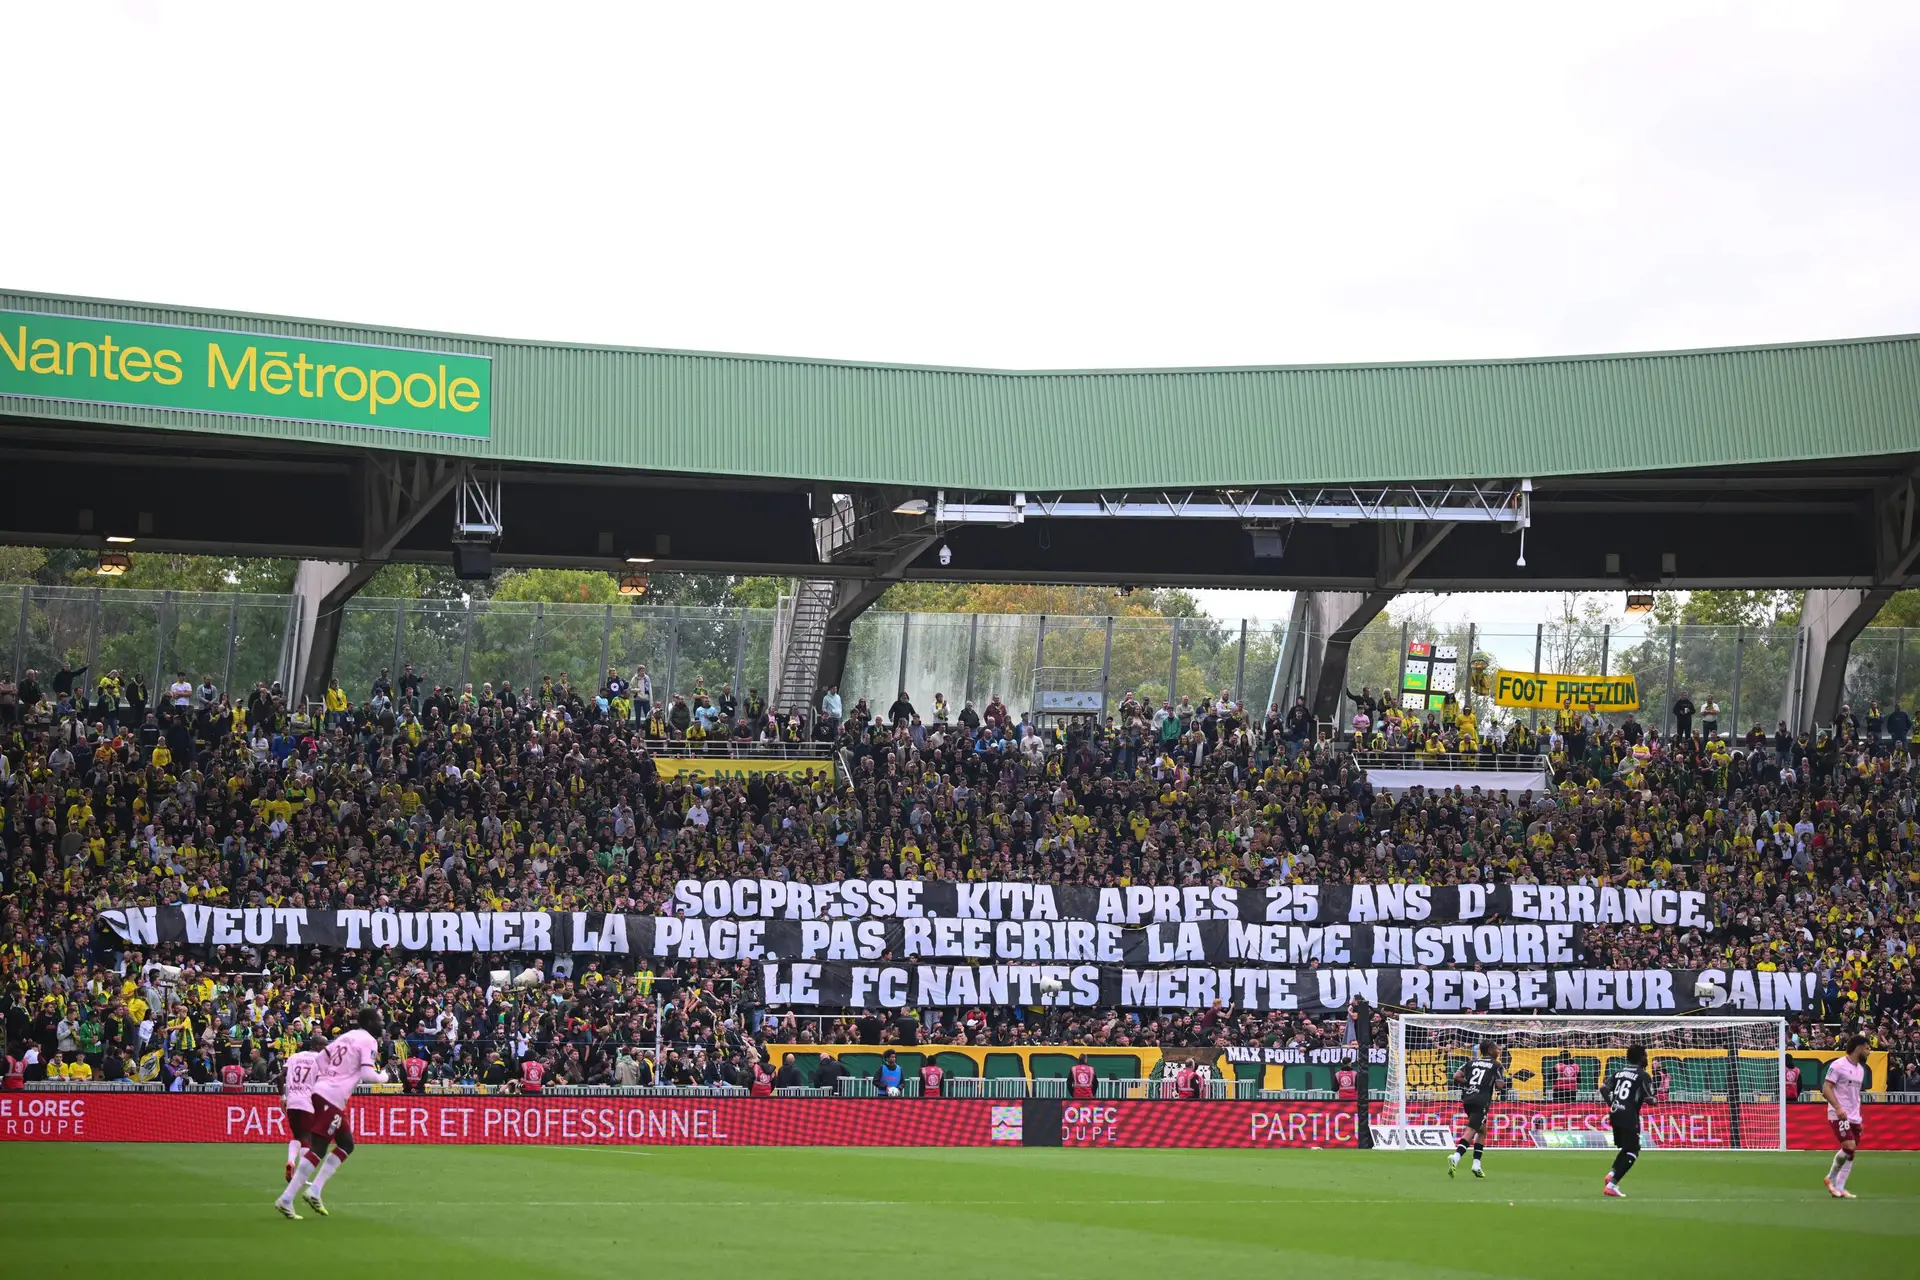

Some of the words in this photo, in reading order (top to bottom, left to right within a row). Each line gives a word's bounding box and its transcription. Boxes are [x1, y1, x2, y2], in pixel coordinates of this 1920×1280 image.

[0, 326, 183, 385] Nantes
[1499, 677, 1547, 702] FOOT
[1556, 681, 1636, 705] PASSION
[1096, 885, 1238, 924] APRES
[1265, 884, 1319, 922] 25
[1349, 883, 1431, 922] ANS
[181, 903, 308, 945] VEUT
[336, 909, 552, 952] TOURNER
[571, 911, 629, 953] LA
[653, 917, 777, 960] PAGE.
[801, 920, 887, 960] PAS
[1147, 922, 1204, 962] LA
[1228, 919, 1350, 964] MEME
[1372, 924, 1584, 966] HISTOIRE.
[763, 963, 822, 1005] LE
[850, 967, 908, 1008] FC
[917, 965, 1099, 1007] NANTES
[1121, 967, 1298, 1010] MERITE
[1315, 969, 1378, 1009] UN
[1697, 969, 1817, 1011] SAIN!
[1226, 1046, 1261, 1063] MAX
[1264, 1048, 1306, 1064] POUR
[1309, 1048, 1387, 1064] TOUJORS
[293, 1066, 311, 1084] 37
[1405, 1064, 1448, 1085] OUS
[1469, 1067, 1486, 1086] 21
[18, 1099, 85, 1117] LOREC
[1062, 1106, 1117, 1124] OREC
[227, 1106, 428, 1137] PARLIER
[440, 1107, 474, 1137] ET
[485, 1108, 727, 1139] PROFESSIONNEL
[1371, 1129, 1450, 1147] MLLET
